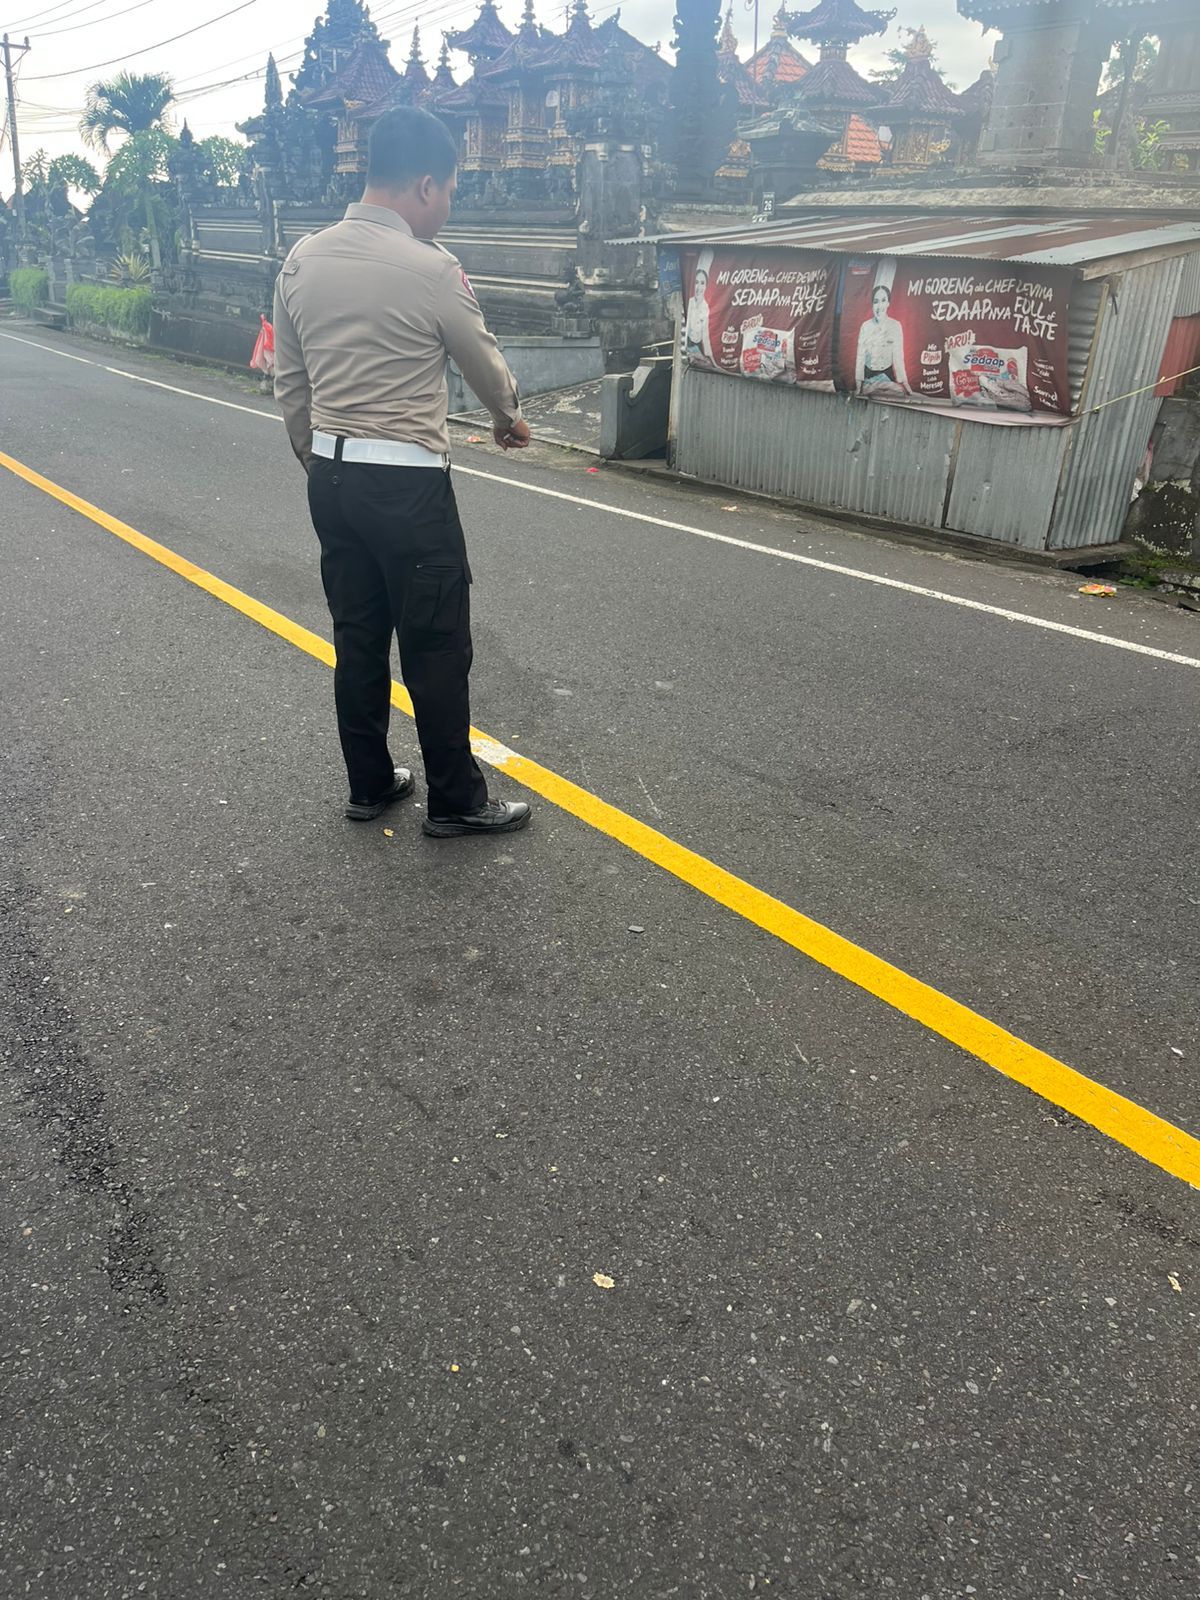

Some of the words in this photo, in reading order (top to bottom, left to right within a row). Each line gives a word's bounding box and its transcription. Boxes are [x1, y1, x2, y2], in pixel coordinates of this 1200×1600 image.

[716, 270, 730, 286] MI
[730, 268, 769, 286] GORENG
[776, 271, 798, 284] CHEF
[907, 278, 924, 297] MI
[924, 276, 975, 297] GORENG
[985, 278, 1017, 294] CHEF
[792, 283, 820, 301] FULL
[790, 294, 828, 317] TASTE
[1013, 313, 1059, 341] TASTE
[963, 353, 1005, 368] Sedaap
